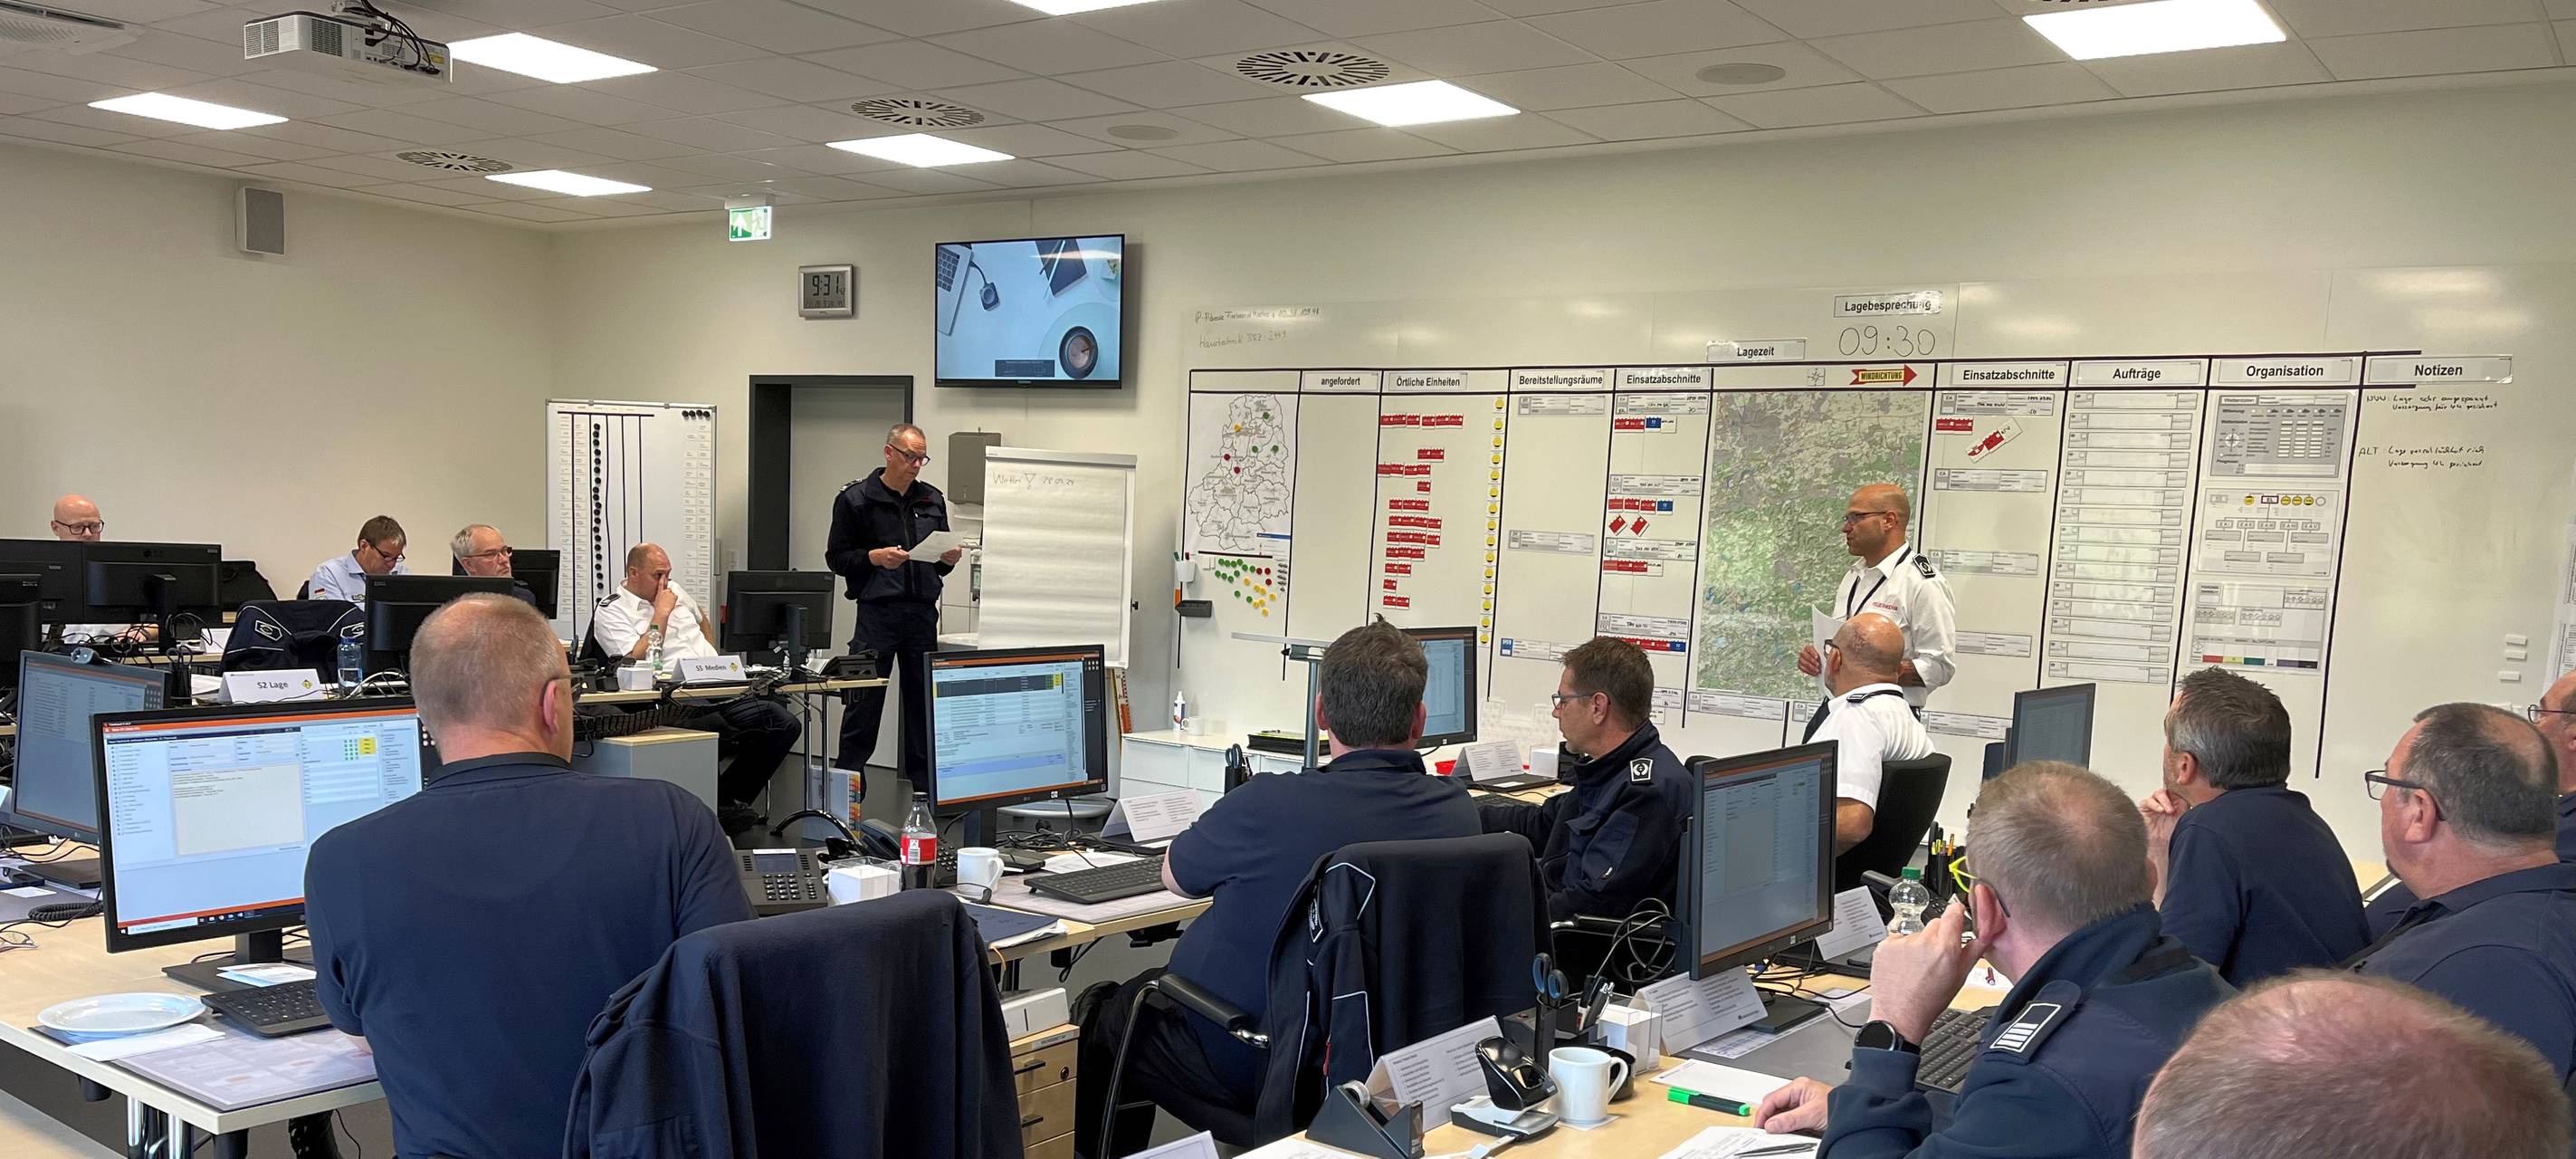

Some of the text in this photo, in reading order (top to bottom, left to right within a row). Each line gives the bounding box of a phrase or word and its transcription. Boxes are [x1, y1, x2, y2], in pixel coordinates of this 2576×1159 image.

[812, 274, 840, 296] 9:31
[1838, 325, 1936, 358] 09:30
[1736, 346, 1775, 359] Lagezeit
[1860, 371, 1903, 380] WINDRICHTUNG
[1962, 369, 2056, 381] Einsatzabschnitte
[2113, 367, 2161, 381] Aufträge
[2246, 365, 2324, 378] Organisation
[2414, 364, 2463, 377] Notizen
[1321, 376, 1360, 388] angefordert
[1396, 375, 1461, 388] Örtliche Einheiten
[1519, 374, 1603, 387] Bereitstellungsräume
[1627, 373, 1702, 385] Einsatzabschnitte
[257, 681, 290, 690] S2 Lage
